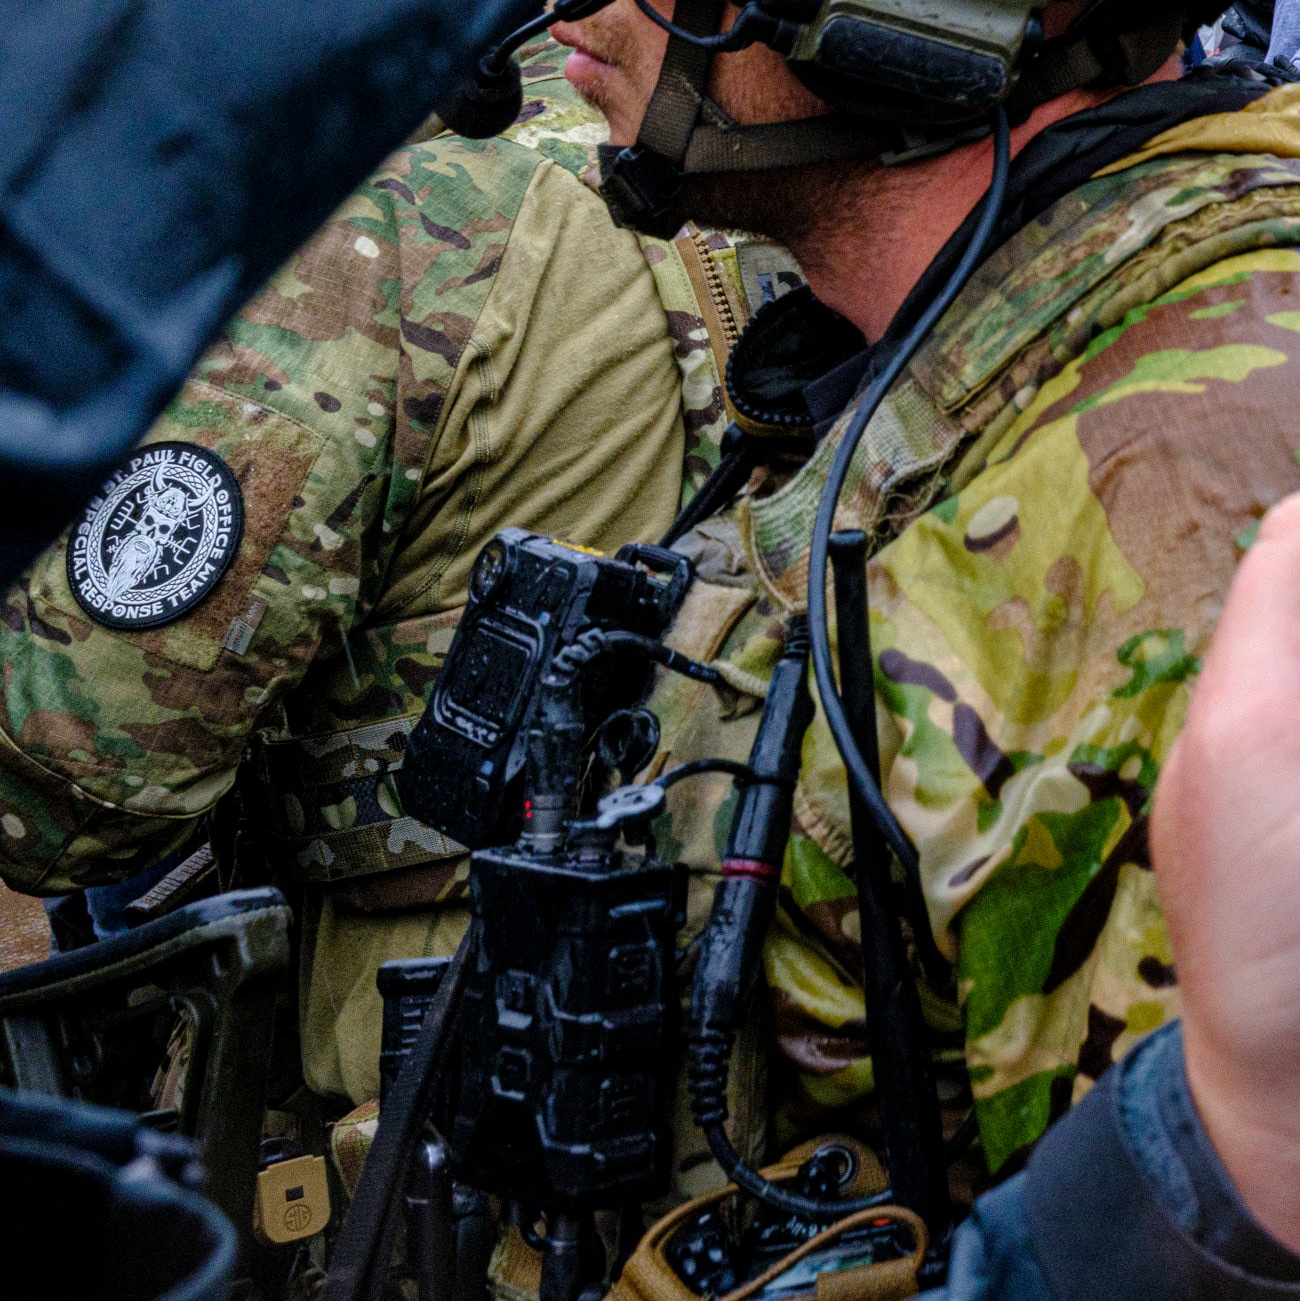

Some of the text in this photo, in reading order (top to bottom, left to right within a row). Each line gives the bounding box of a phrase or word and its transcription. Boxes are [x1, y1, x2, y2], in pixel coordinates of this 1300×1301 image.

[130, 449, 176, 472] PAUL
[178, 452, 222, 488] FIELD
[212, 490, 232, 559] OFFICE
[78, 581, 164, 619] RESPONSE
[167, 563, 216, 608] TEAM
